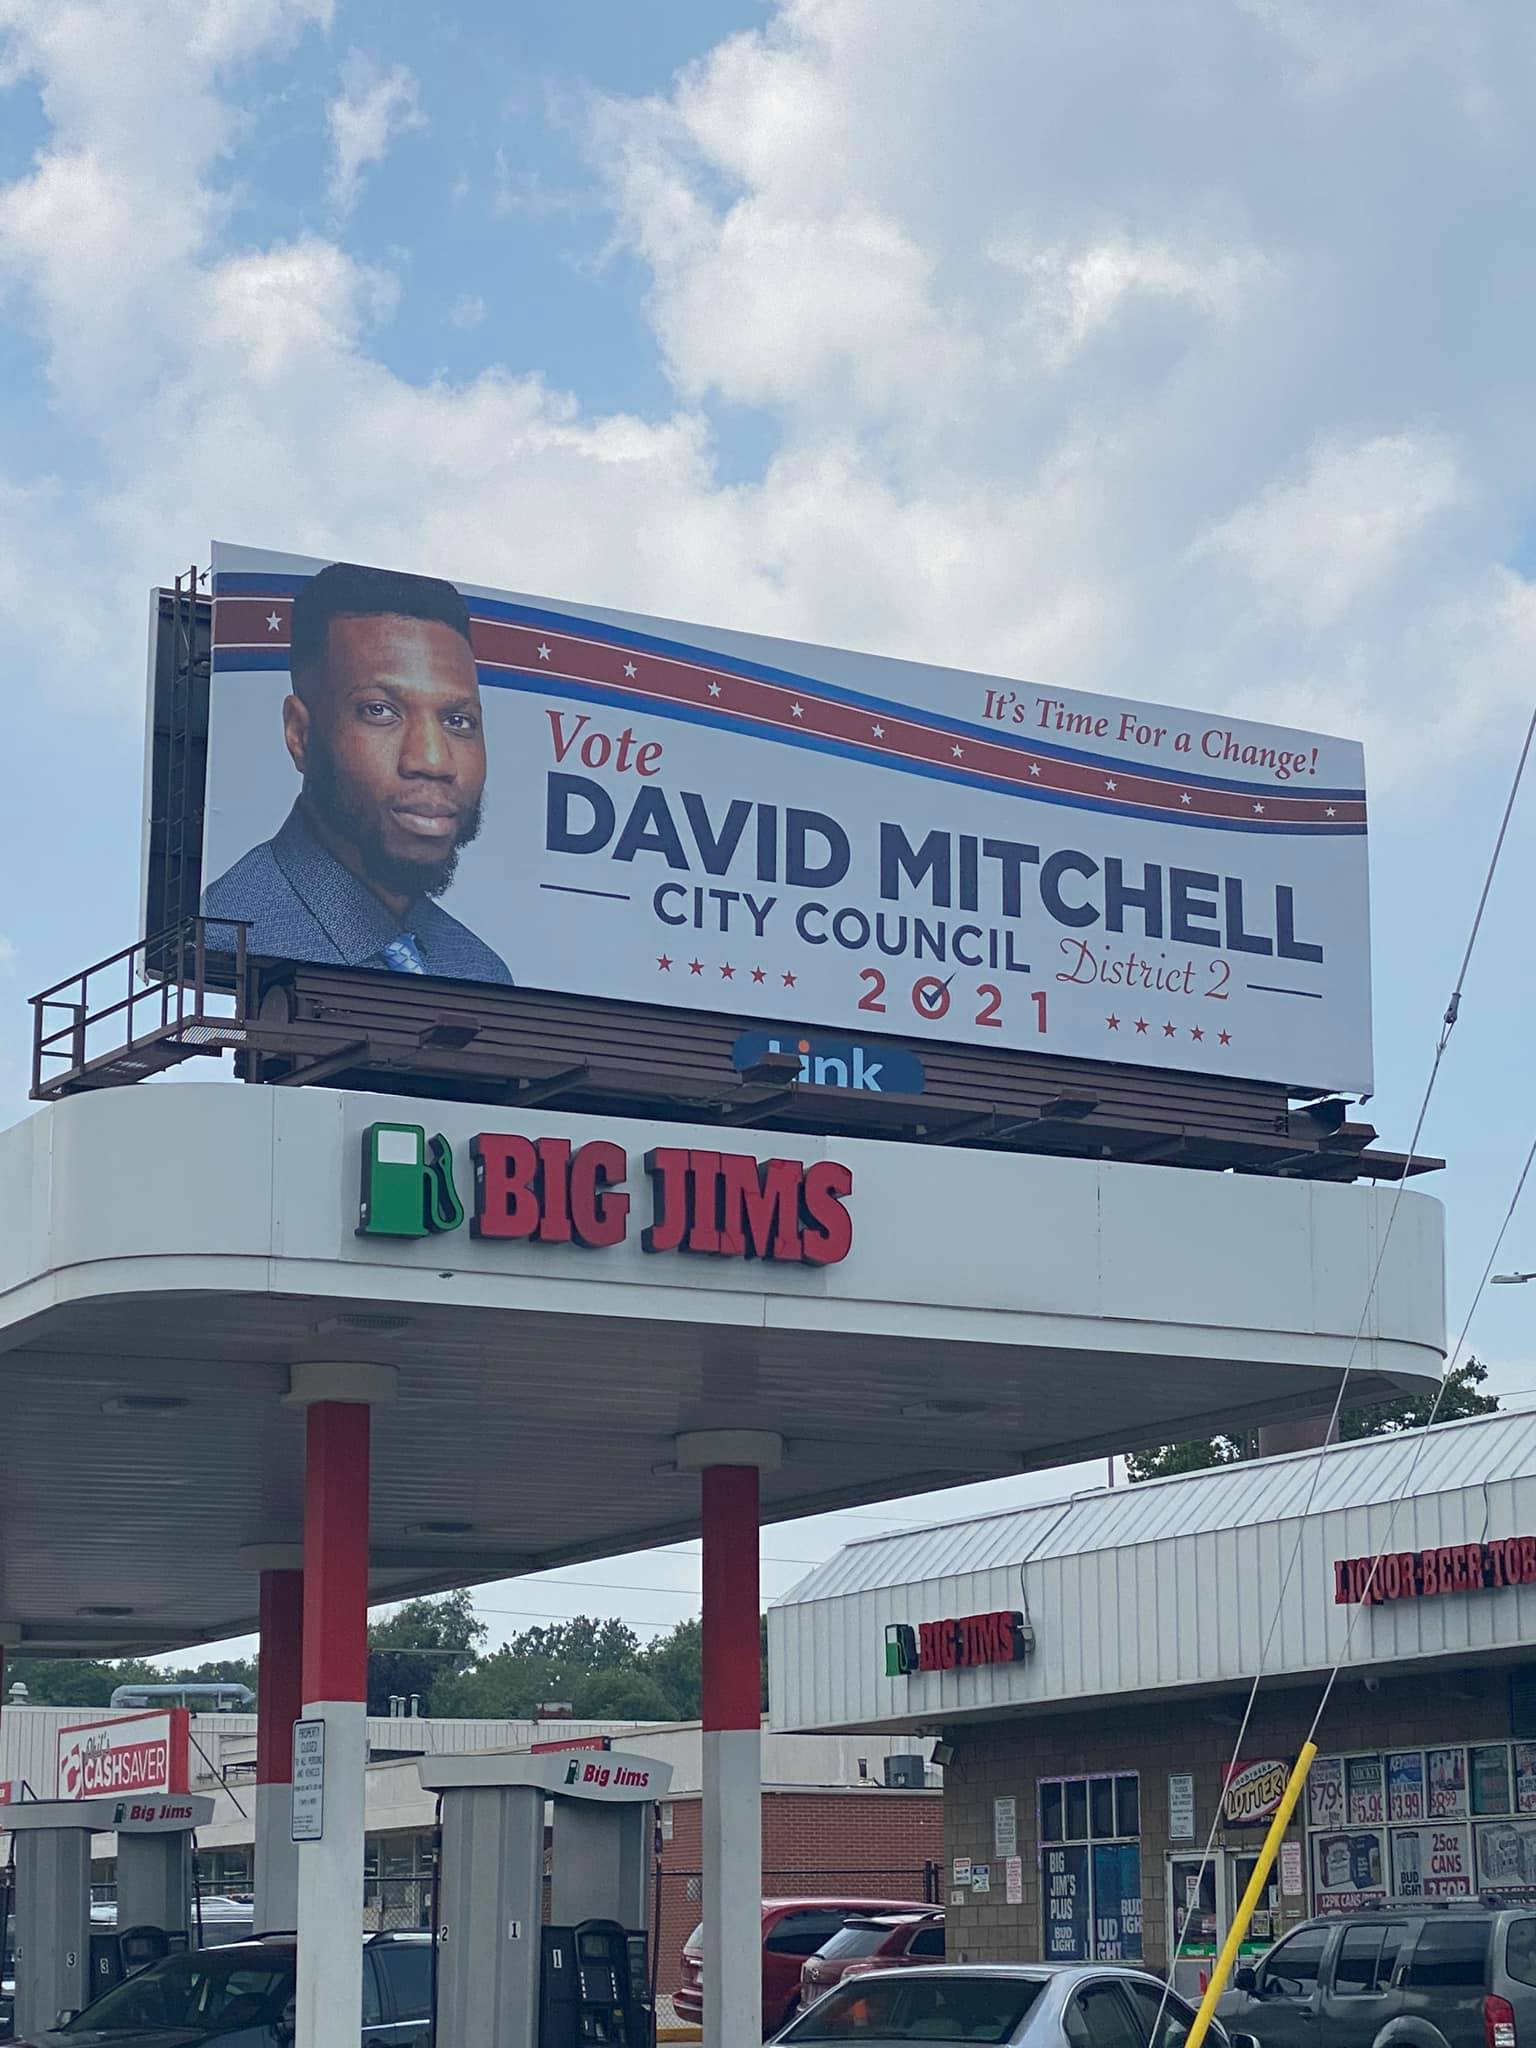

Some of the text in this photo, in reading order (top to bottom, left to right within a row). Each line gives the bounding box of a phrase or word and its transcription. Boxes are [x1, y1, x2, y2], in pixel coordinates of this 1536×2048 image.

[545, 709, 663, 776] Vote
[982, 689, 1319, 780] It's Time For a Change!
[546, 770, 1323, 964] DAVID MITCHELL
[653, 882, 1031, 974] CITY COUNCIL
[1056, 938, 1231, 1000] District 2
[857, 966, 1047, 1034] 2021
[469, 1132, 853, 1267] BIG JIMS
[1334, 1551, 1416, 1606] LIQUOR
[1421, 1543, 1484, 1595] BEER
[919, 1611, 1016, 1672] BIG JIMS
[84, 1747, 165, 1790] CASHSAVER
[583, 1764, 649, 1787] Big Jims
[1226, 1764, 1291, 1821] LOTTERY
[130, 1805, 193, 1823] Big Jims
[1432, 1833, 1459, 1852] 25oz
[1049, 1851, 1065, 1873] BIG
[1431, 1855, 1462, 1874] CANS
[1050, 1874, 1076, 1897] JIM'S
[1400, 1871, 1419, 1884] BUD
[1050, 1898, 1073, 1920] PLUS
[441, 1926, 449, 1941] 2
[511, 1922, 518, 1938] 1
[1054, 1927, 1073, 1939] BUD
[1051, 1939, 1076, 1952] LIGHT
[67, 1953, 76, 1966] 3
